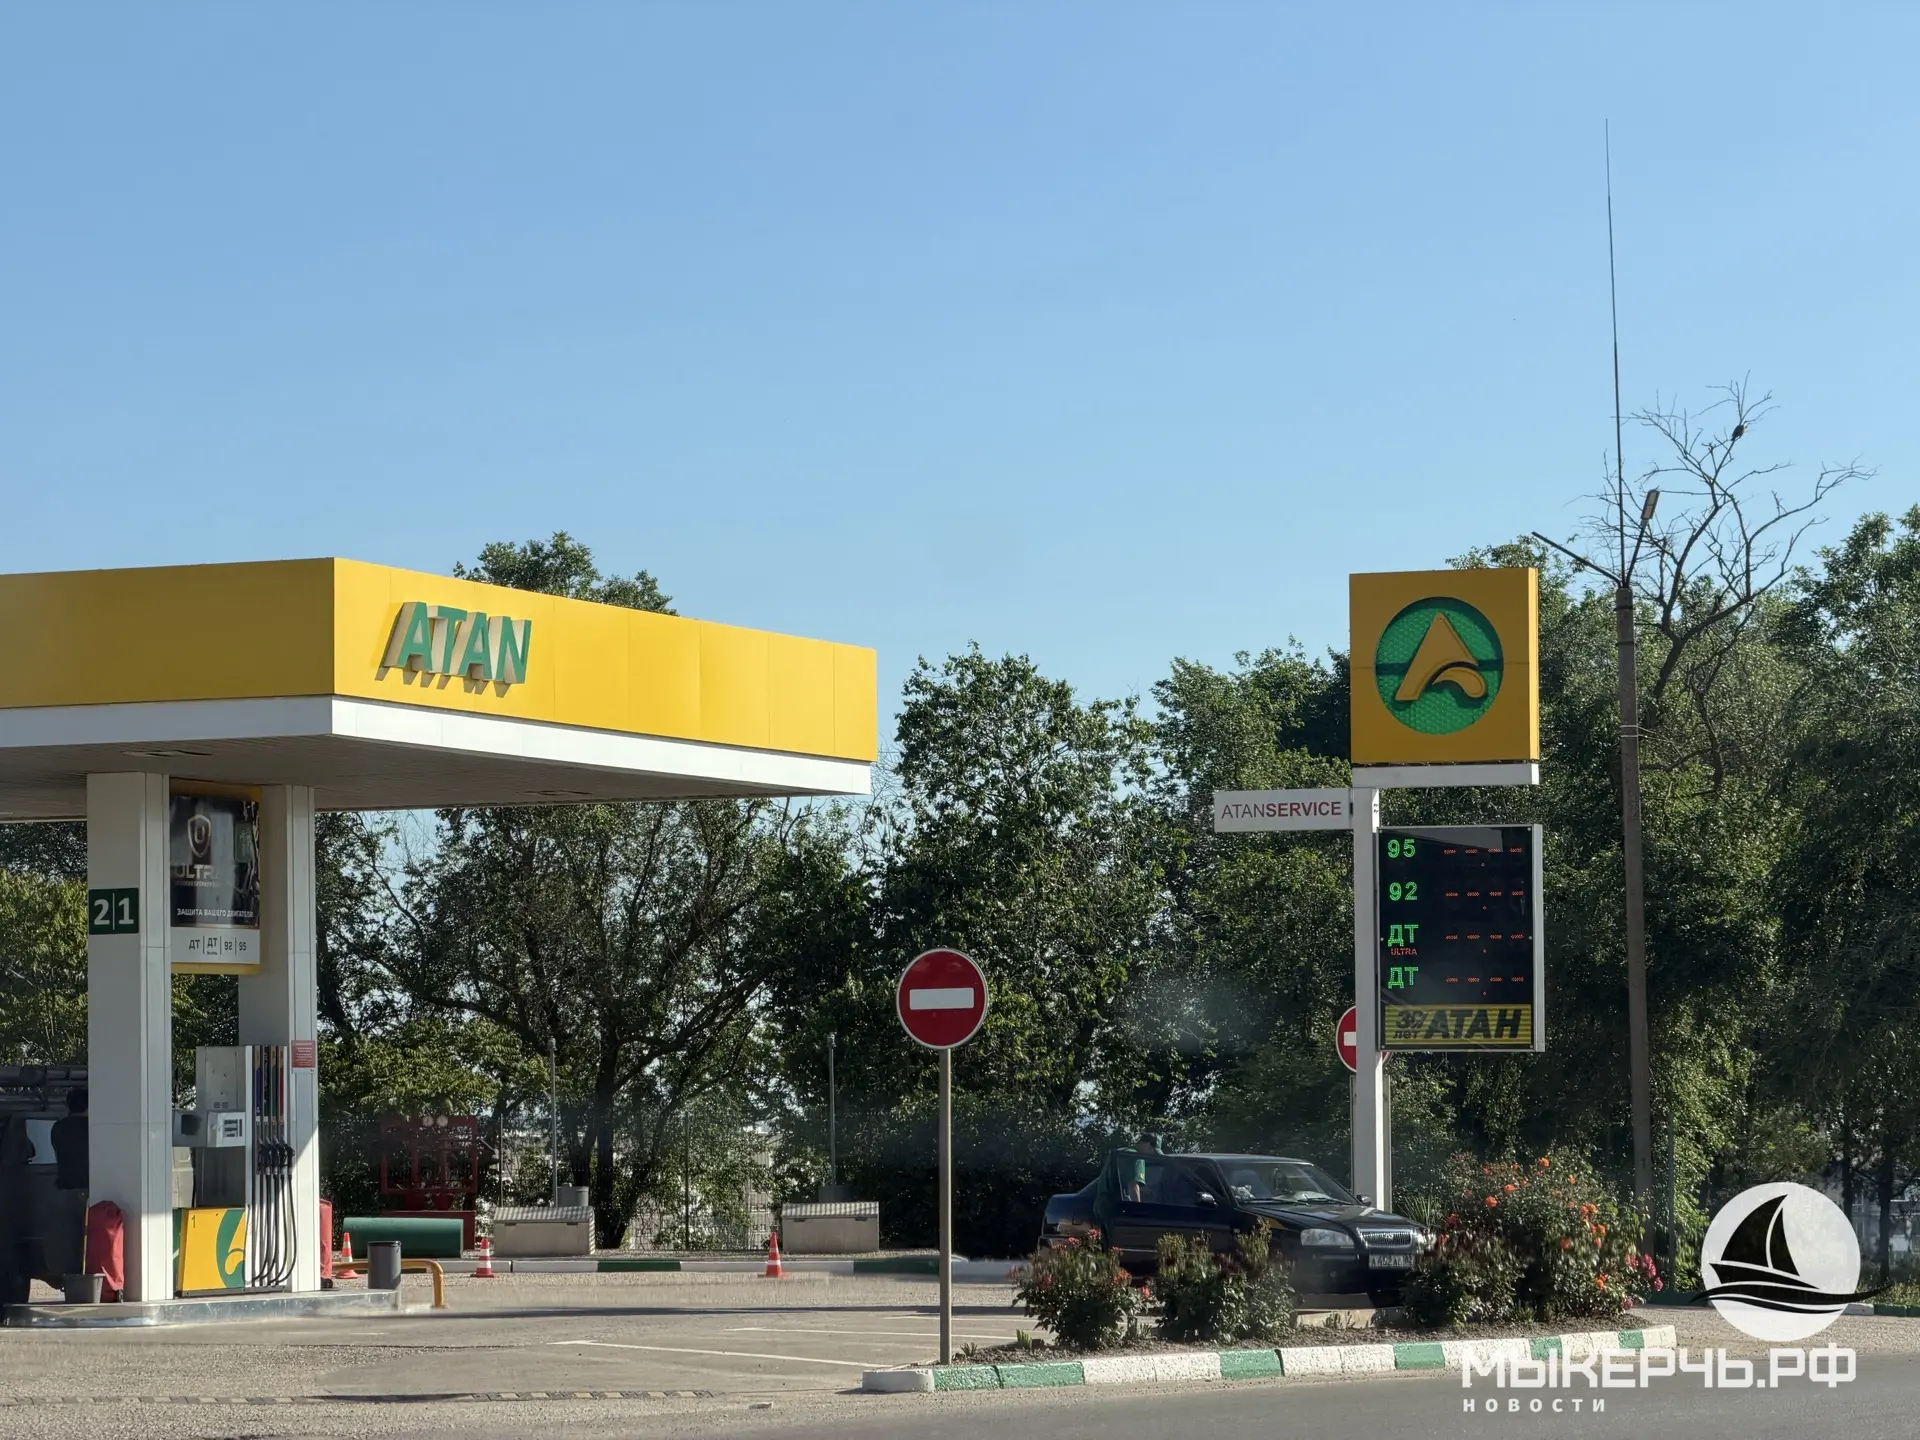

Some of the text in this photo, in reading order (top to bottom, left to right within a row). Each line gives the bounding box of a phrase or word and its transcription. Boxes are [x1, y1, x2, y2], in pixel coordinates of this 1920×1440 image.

[390, 601, 532, 684] ATAN
[1221, 801, 1342, 819] ATANSERVICE
[1388, 839, 1416, 858] 95
[1389, 882, 1417, 900] 92
[177, 908, 203, 916] ЗАЩИТА
[189, 937, 247, 951] ДТ ДТ 92 95
[1388, 924, 1419, 946] ДТ
[1390, 947, 1417, 956] ULTRA
[1388, 967, 1419, 989] ДТ
[1423, 1008, 1523, 1039] АТАН
